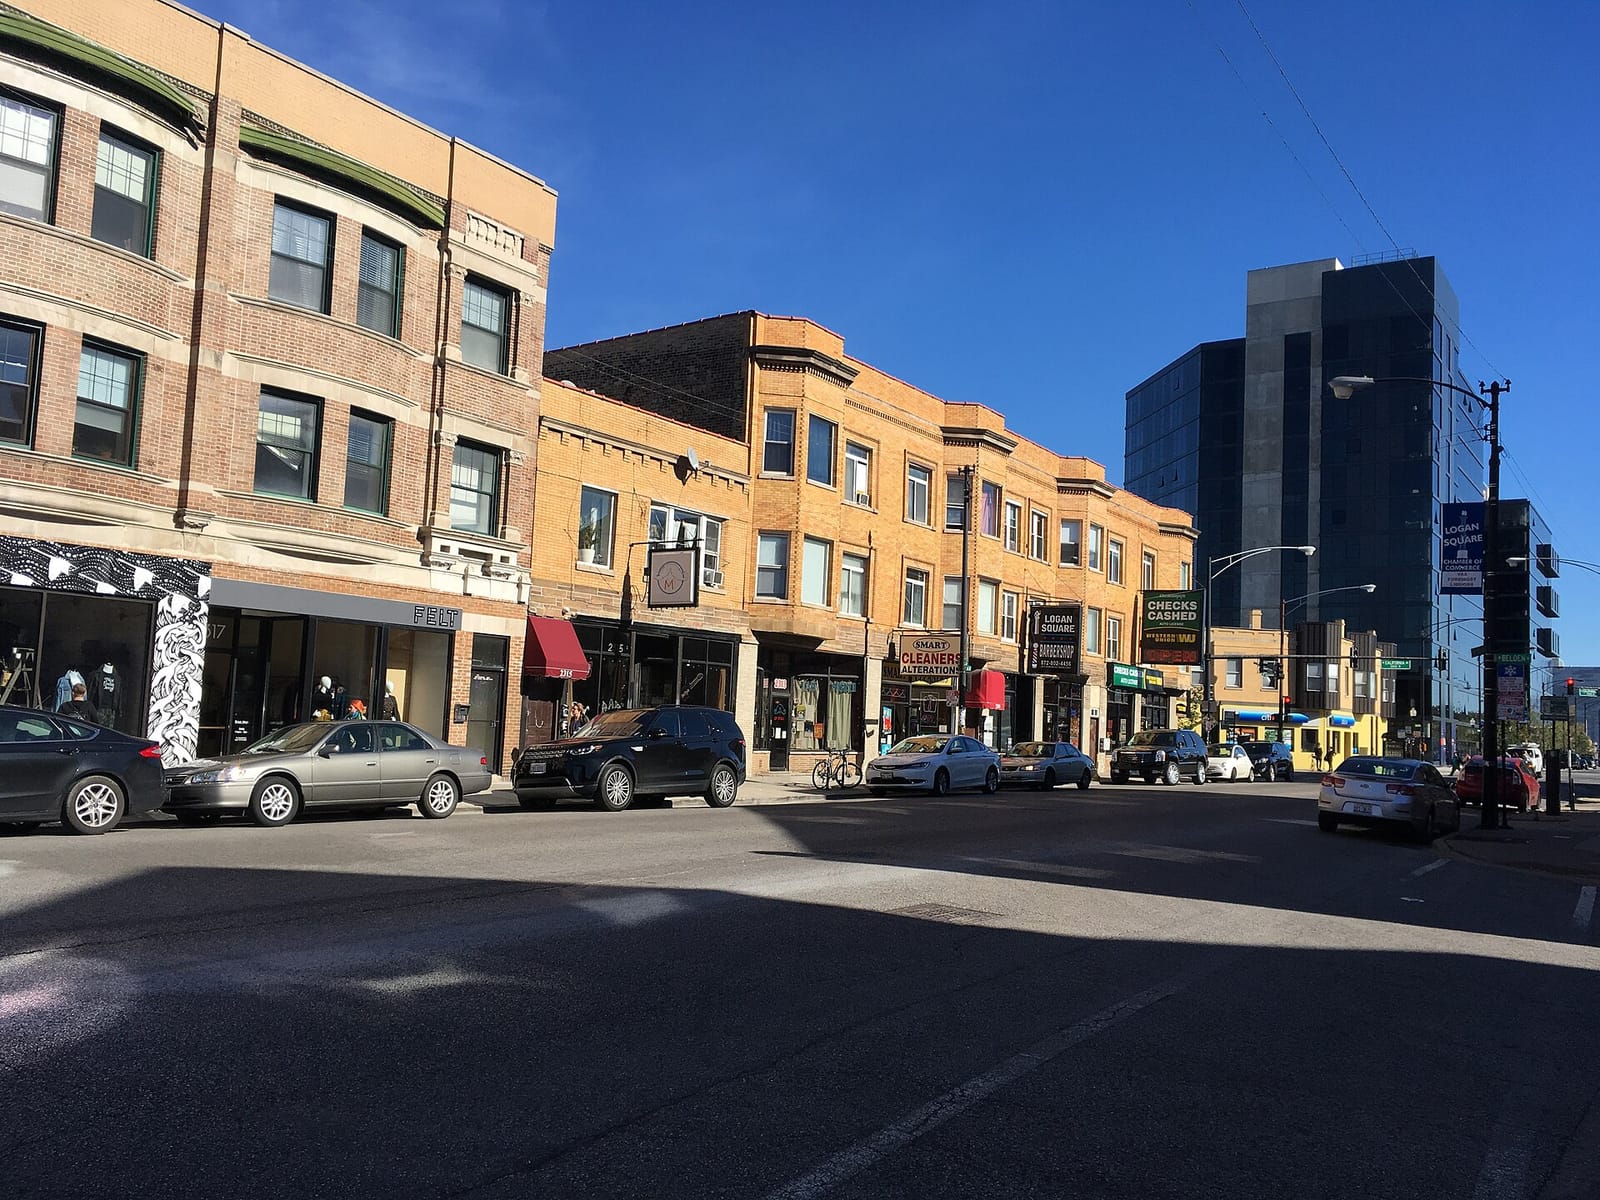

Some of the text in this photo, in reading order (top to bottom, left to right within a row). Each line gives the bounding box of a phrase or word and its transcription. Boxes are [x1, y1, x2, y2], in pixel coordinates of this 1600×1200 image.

[1445, 523, 1480, 535] LOGAN
[1443, 534, 1484, 547] SQUARE
[1147, 601, 1198, 611] CHECKS
[413, 605, 459, 628] FELT
[1044, 614, 1073, 624] LOGAN
[1147, 611, 1197, 621] CASHED
[1041, 623, 1076, 633] SQUARE
[914, 640, 947, 650] SMART
[1039, 643, 1075, 659] BARBERSHOP
[901, 652, 961, 665] CLEANERS
[1501, 654, 1526, 662] BELDEN
[901, 665, 960, 675] ALTERATIONS
